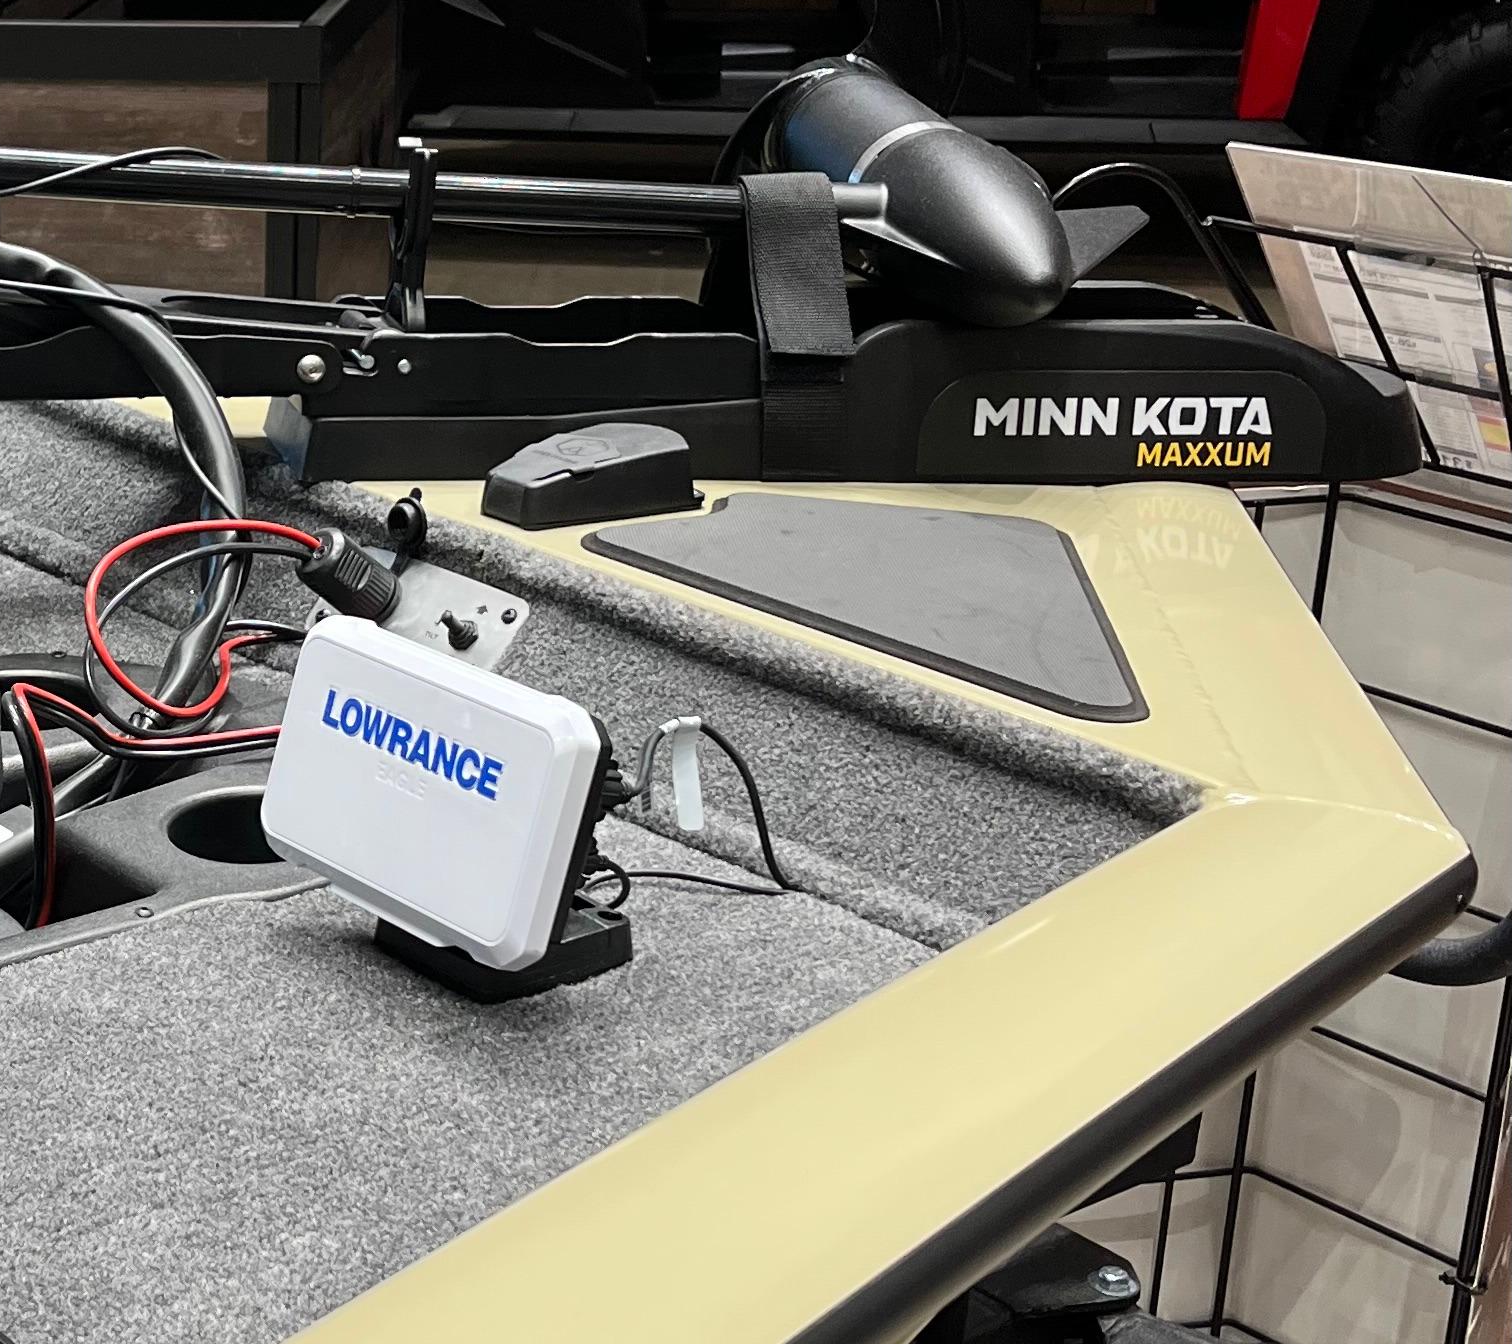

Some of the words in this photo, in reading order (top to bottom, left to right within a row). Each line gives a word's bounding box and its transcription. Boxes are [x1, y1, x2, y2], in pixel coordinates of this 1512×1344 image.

[973, 397, 1119, 436] MINN
[1131, 397, 1272, 436] KOTA
[1136, 442, 1271, 467] MAXXUM
[321, 689, 504, 801] LOWRANCE
[375, 758, 427, 801] EAGLE
